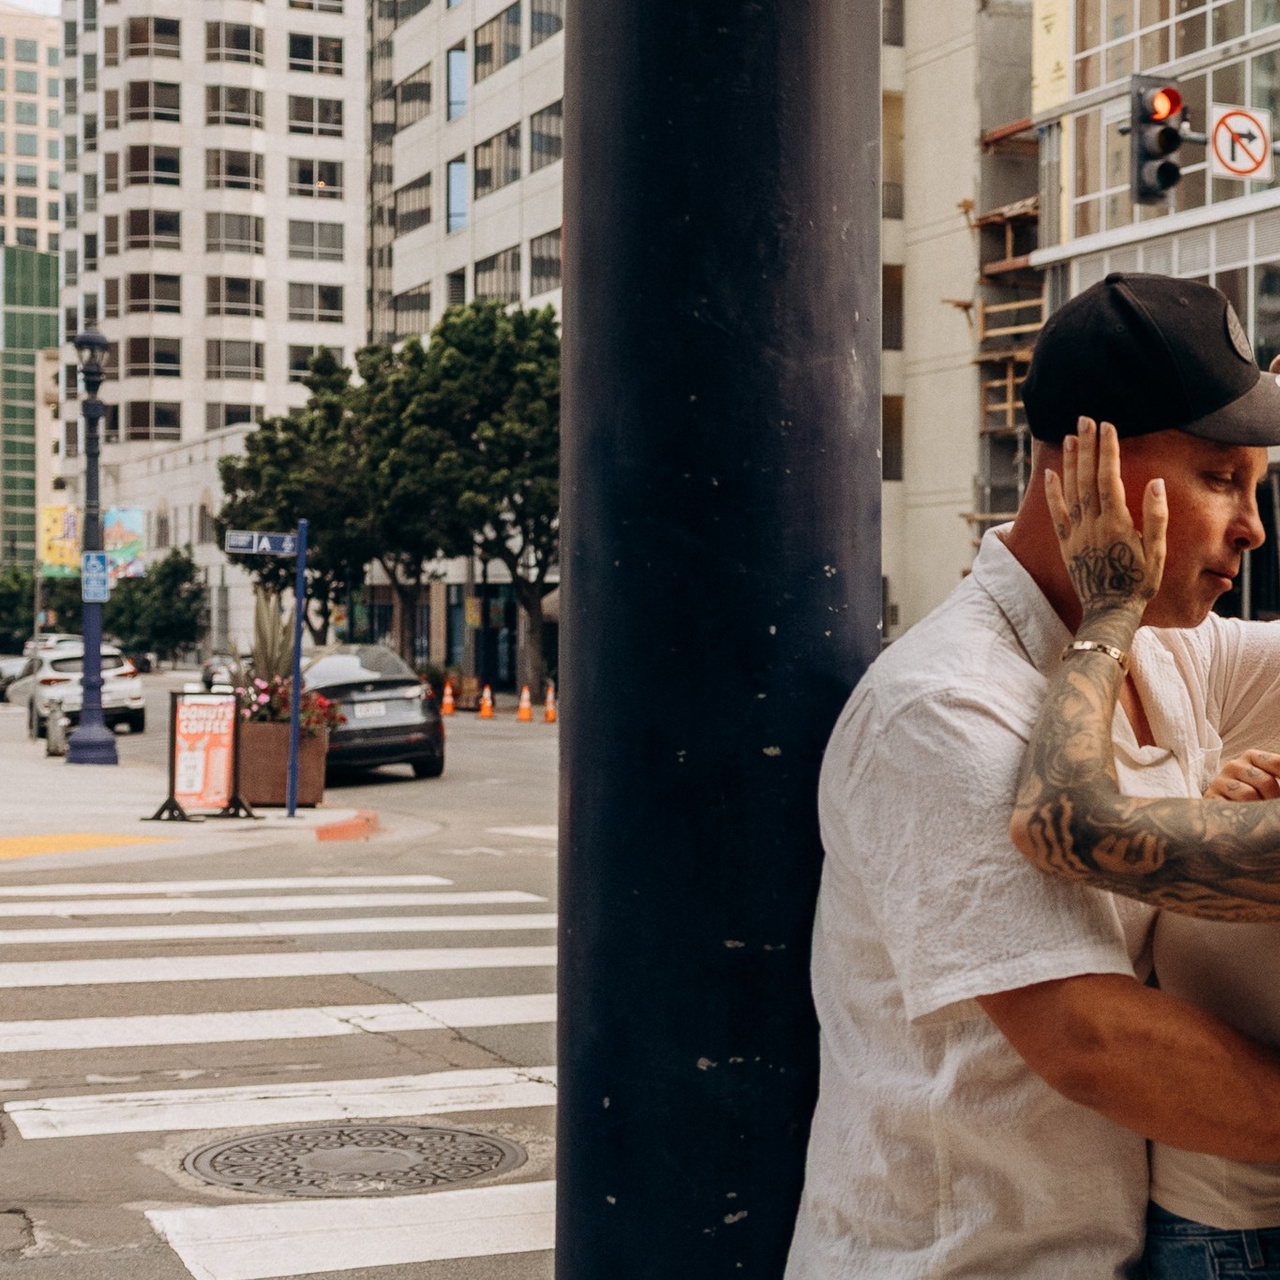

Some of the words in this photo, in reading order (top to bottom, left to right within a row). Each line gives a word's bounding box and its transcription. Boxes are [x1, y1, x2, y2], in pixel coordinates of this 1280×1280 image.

[259, 535, 272, 552] A
[179, 706, 233, 721] DONUTS
[179, 720, 229, 734] COFFEE
